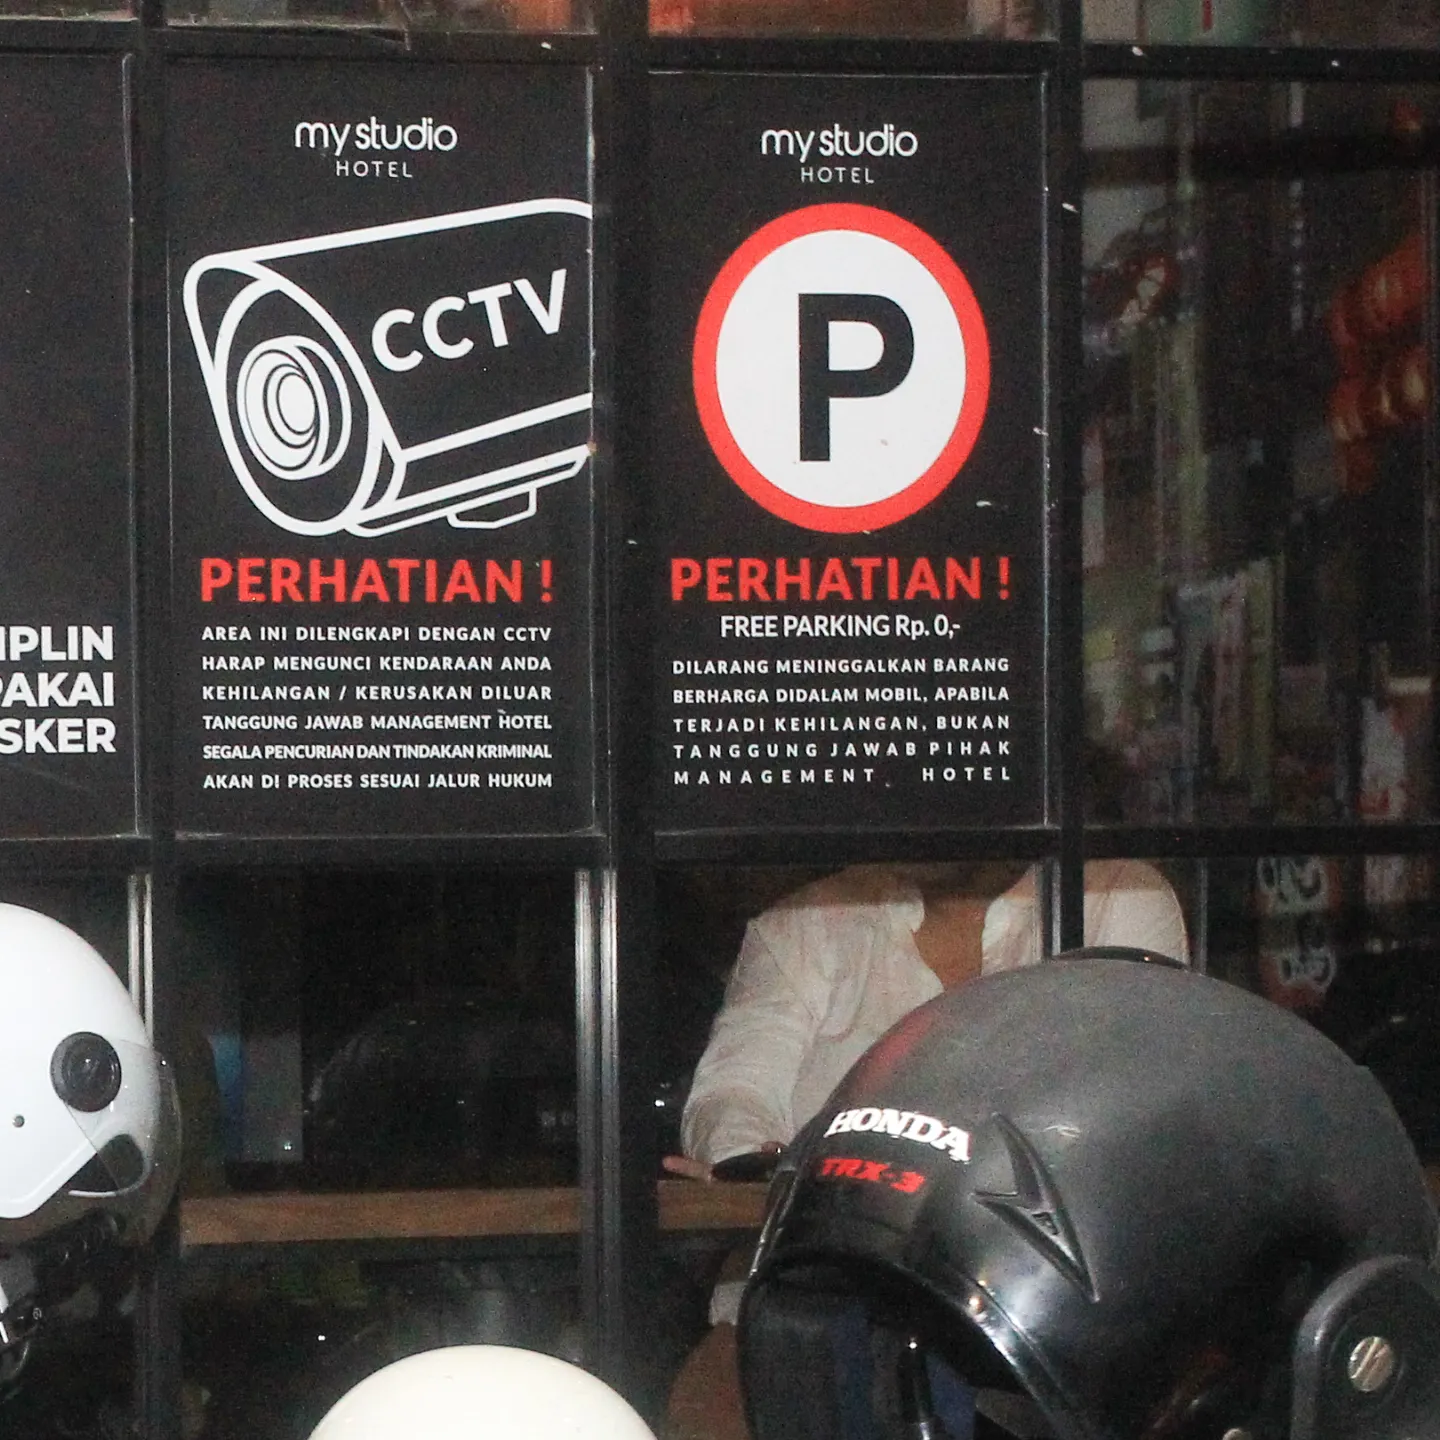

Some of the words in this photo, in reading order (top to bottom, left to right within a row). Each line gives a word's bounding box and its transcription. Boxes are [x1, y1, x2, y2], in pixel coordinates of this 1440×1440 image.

[335, 160, 413, 178] HOTEL
[800, 166, 875, 184] HOTEL
[371, 268, 568, 372] CCTV
[798, 293, 914, 461] P
[201, 625, 252, 641] AREA
[260, 626, 287, 641] INI
[295, 626, 410, 642] DILENGKAPI
[418, 626, 496, 642] DENGAN
[503, 626, 552, 642] CCTV
[720, 615, 779, 638] FREE
[783, 614, 891, 638] PARKING
[895, 614, 930, 641] Rp.
[933, 613, 961, 640] 0,-
[202, 655, 266, 671] HARAP
[273, 655, 371, 671] MENGUNCI
[379, 655, 493, 671] KENDARAAN
[500, 656, 552, 671] ANDA
[672, 659, 769, 675] DILARANG
[776, 658, 926, 674] MENINGGALKAN
[933, 657, 1009, 673] BARANG
[203, 686, 329, 700] KEHILANGAN
[356, 686, 472, 700] KERUSAKAN
[482, 686, 551, 700] DILUAR
[673, 688, 770, 704] BERHARGA
[775, 687, 859, 703] DIDALAM
[865, 687, 928, 703] MOBIL,
[934, 686, 1010, 702] APABILA
[202, 715, 298, 731] TANGGUNG
[304, 714, 364, 730] JAWAB
[370, 714, 492, 730] MANAGEMENT
[497, 714, 553, 730] HOTEL
[672, 717, 765, 733] TERJADI
[774, 715, 927, 733] KEHILANGAN,
[936, 714, 1010, 730] BUKAN
[202, 744, 263, 760] SEGALA
[264, 744, 355, 760] PENCURIAN
[356, 744, 391, 759] DAN
[392, 744, 475, 759] TINDAKAN
[476, 743, 553, 759] KRIMINAL
[672, 743, 818, 759] TANGGUNG
[830, 741, 916, 758] JAWAB
[929, 740, 1010, 756] PIHAK
[202, 774, 254, 789] AKAN
[261, 774, 280, 789] DI
[287, 773, 353, 789] PROSES
[359, 773, 420, 789] SESUAI
[427, 773, 481, 788] JALUR
[488, 772, 553, 788] HUKUM
[674, 768, 874, 784] MANAGEMENT
[922, 766, 1010, 782] HOTEL
[823, 1107, 972, 1165] HONDA
